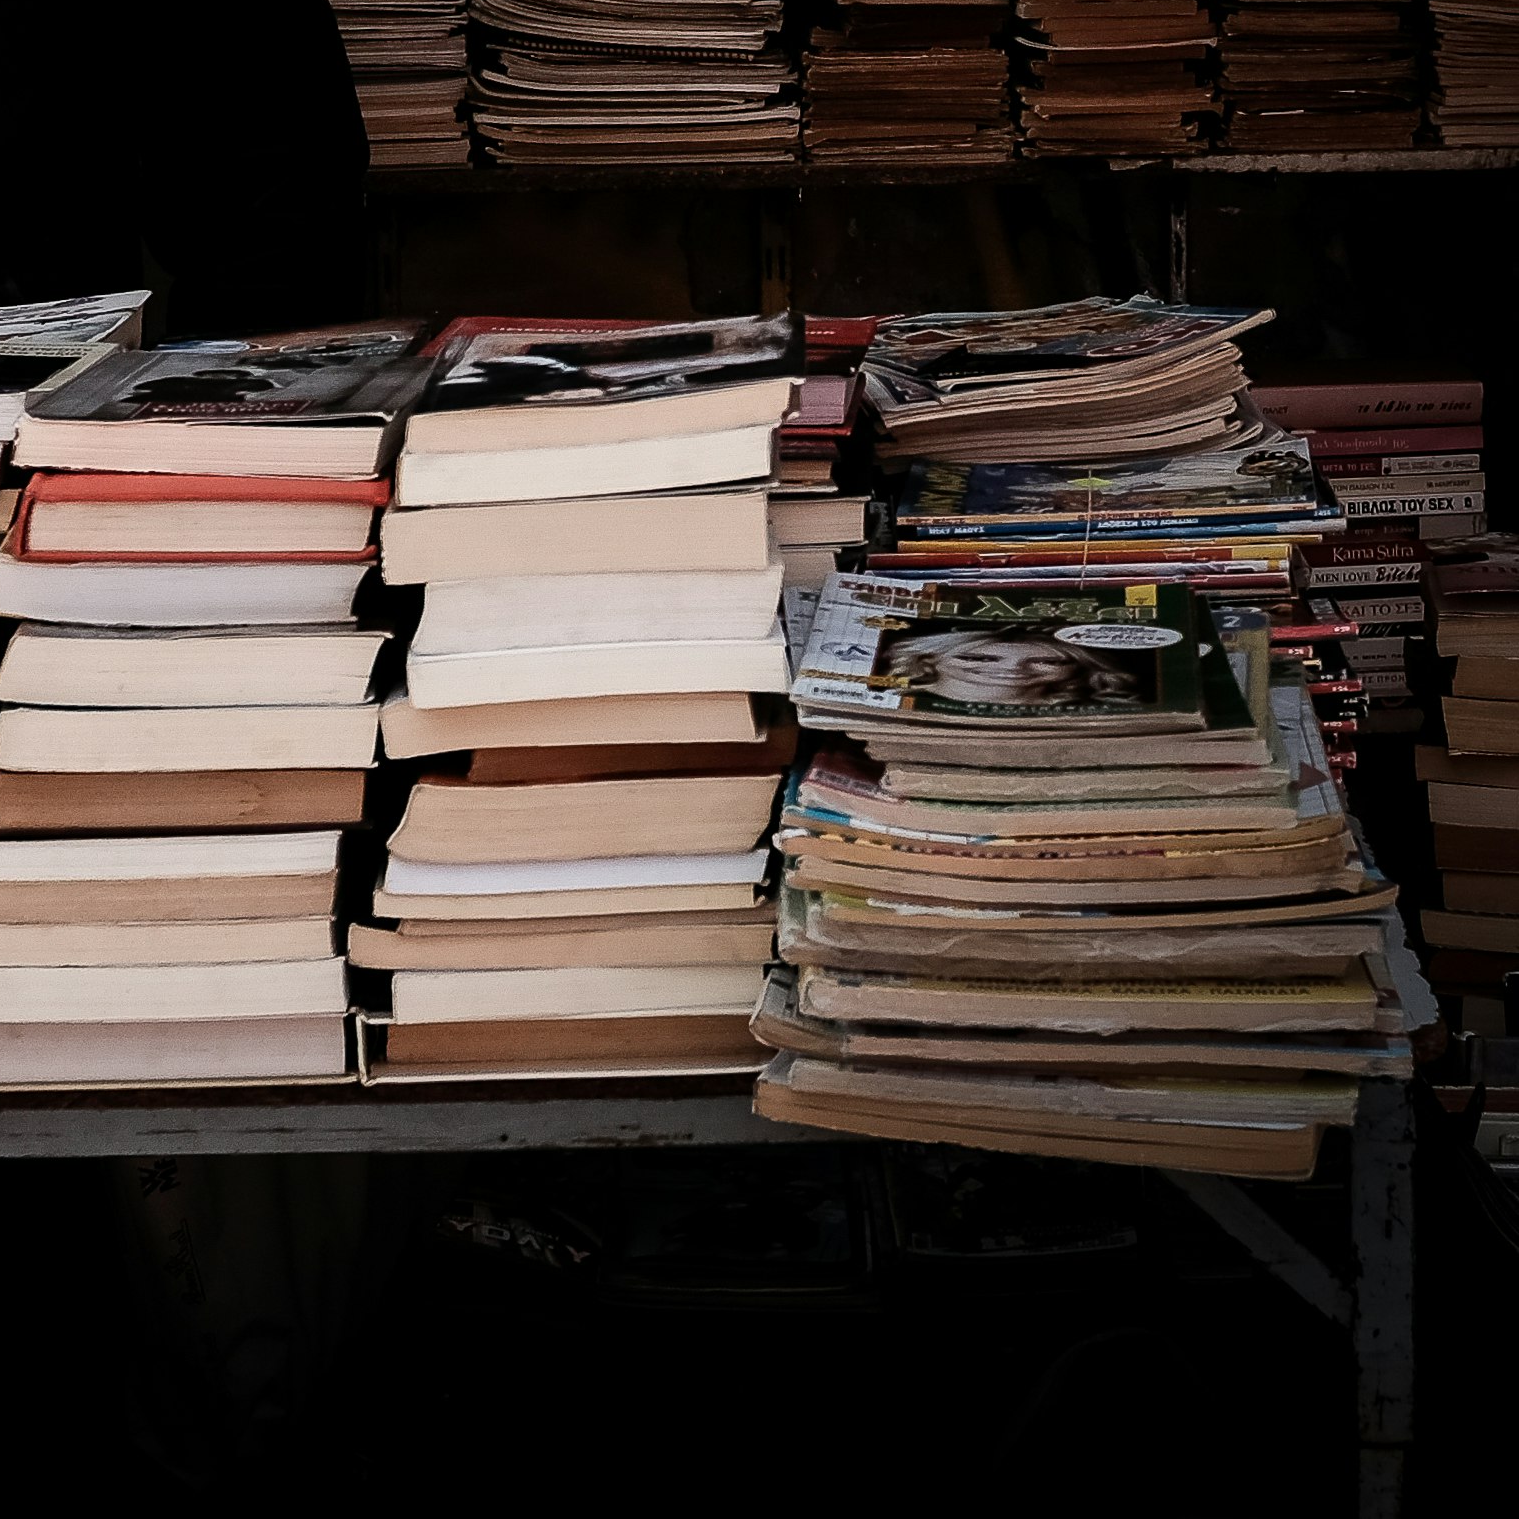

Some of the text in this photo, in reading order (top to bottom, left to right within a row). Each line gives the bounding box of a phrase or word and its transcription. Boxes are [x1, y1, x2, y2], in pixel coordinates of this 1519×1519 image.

[1322, 463, 1359, 472] ΜΕΤΑ ΤΟ
[1347, 497, 1454, 515] ΒΙΒΛΟΣ ΤΟΥ SEX
[1333, 544, 1414, 562] Kama Sutra
[1315, 572, 1370, 583] MEN LOVE
[1342, 606, 1366, 617] ΚΑΙ
[1371, 605, 1392, 616] ΤΟ
